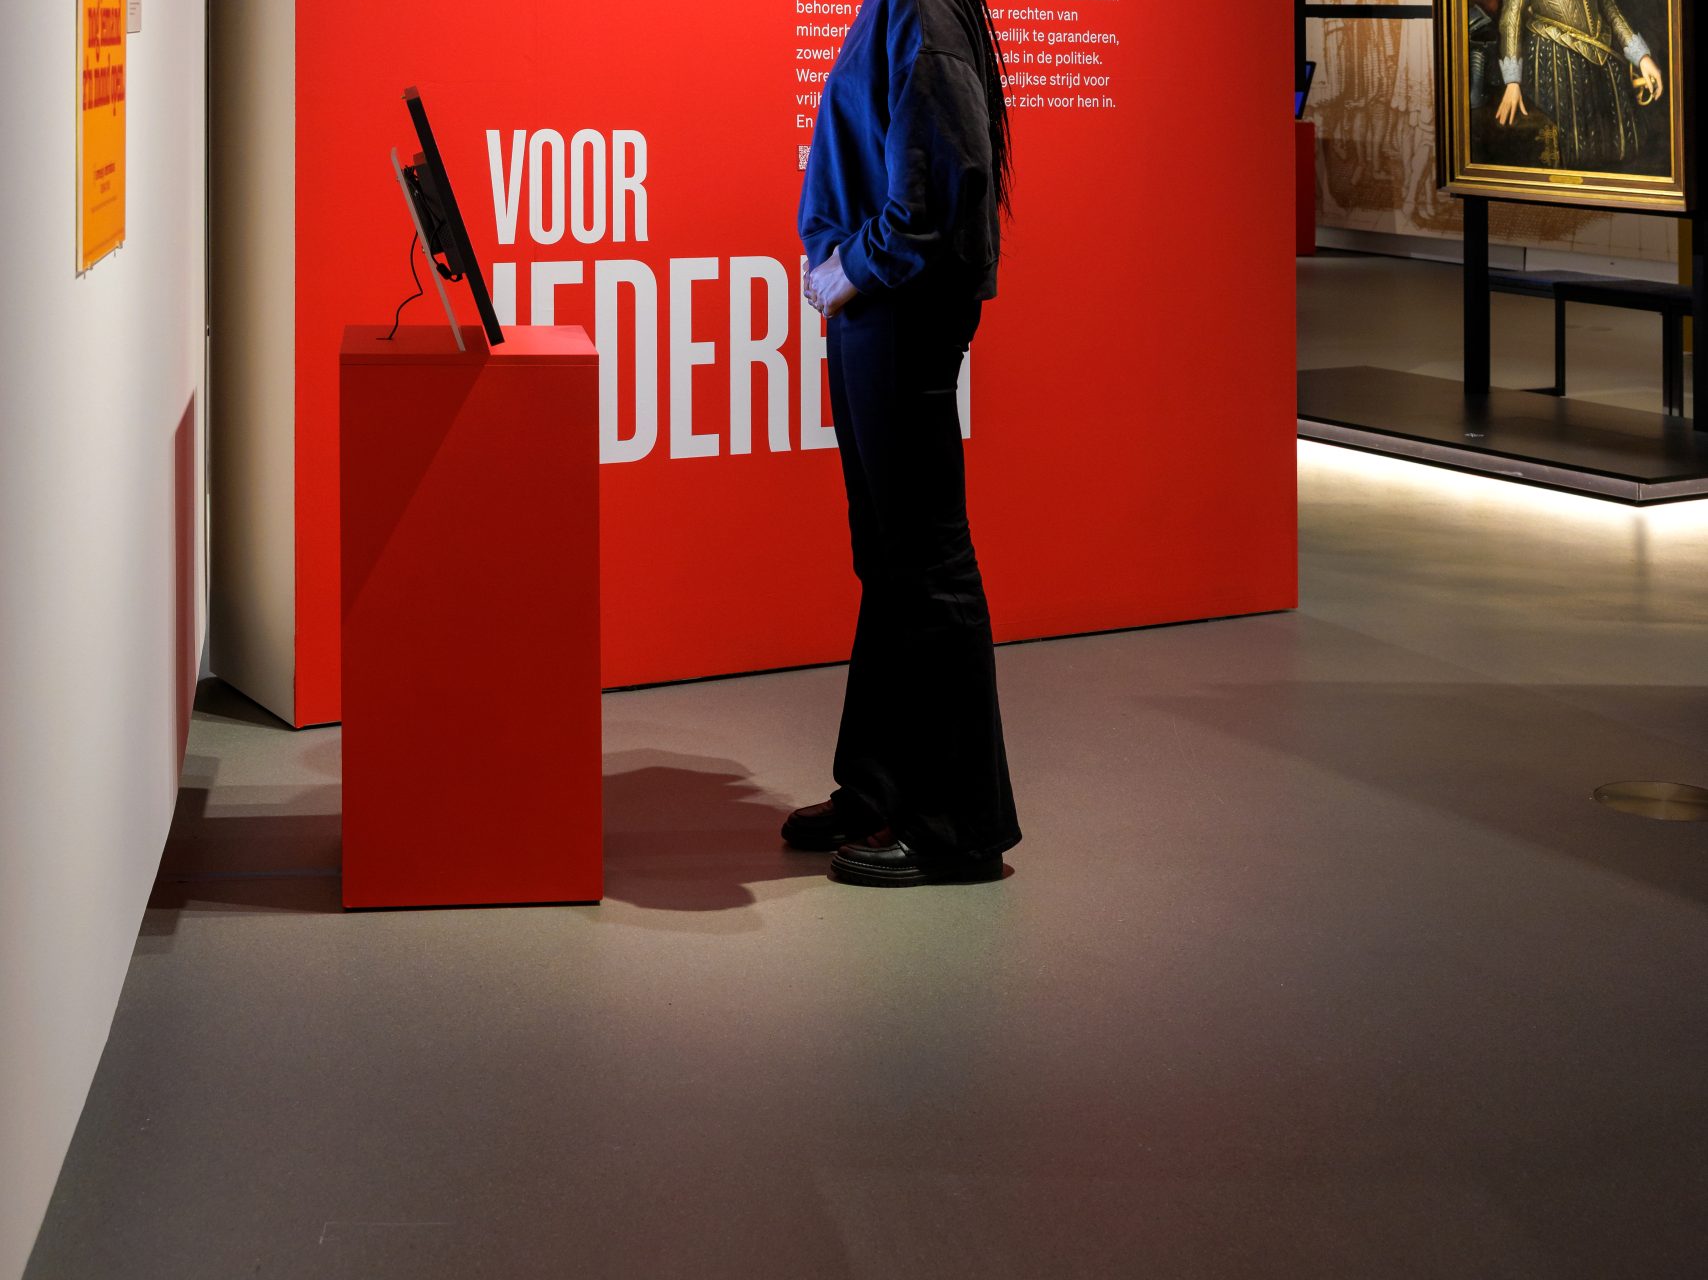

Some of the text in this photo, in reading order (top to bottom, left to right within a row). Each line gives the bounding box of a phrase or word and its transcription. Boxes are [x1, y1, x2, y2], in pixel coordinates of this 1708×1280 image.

[796, 0, 852, 15] behoren
[1008, 7, 1054, 20] rechten
[1057, 10, 1078, 21] van
[796, 22, 850, 37] minderh
[1032, 29, 1045, 42] te
[1048, 30, 1119, 45] garanderen,
[796, 46, 834, 60] zowel
[1023, 50, 1034, 63] in
[1037, 51, 1052, 64] de
[1055, 51, 1102, 66] politiek.
[796, 68, 1110, 88] Were gelijkse strijd voor
[1004, 95, 1016, 107] et
[1020, 94, 1044, 107] zich
[1047, 97, 1074, 107] voor
[1077, 95, 1099, 107] hen
[1102, 95, 1115, 107] in.
[796, 114, 813, 128] En
[485, 128, 649, 245] VOOR
